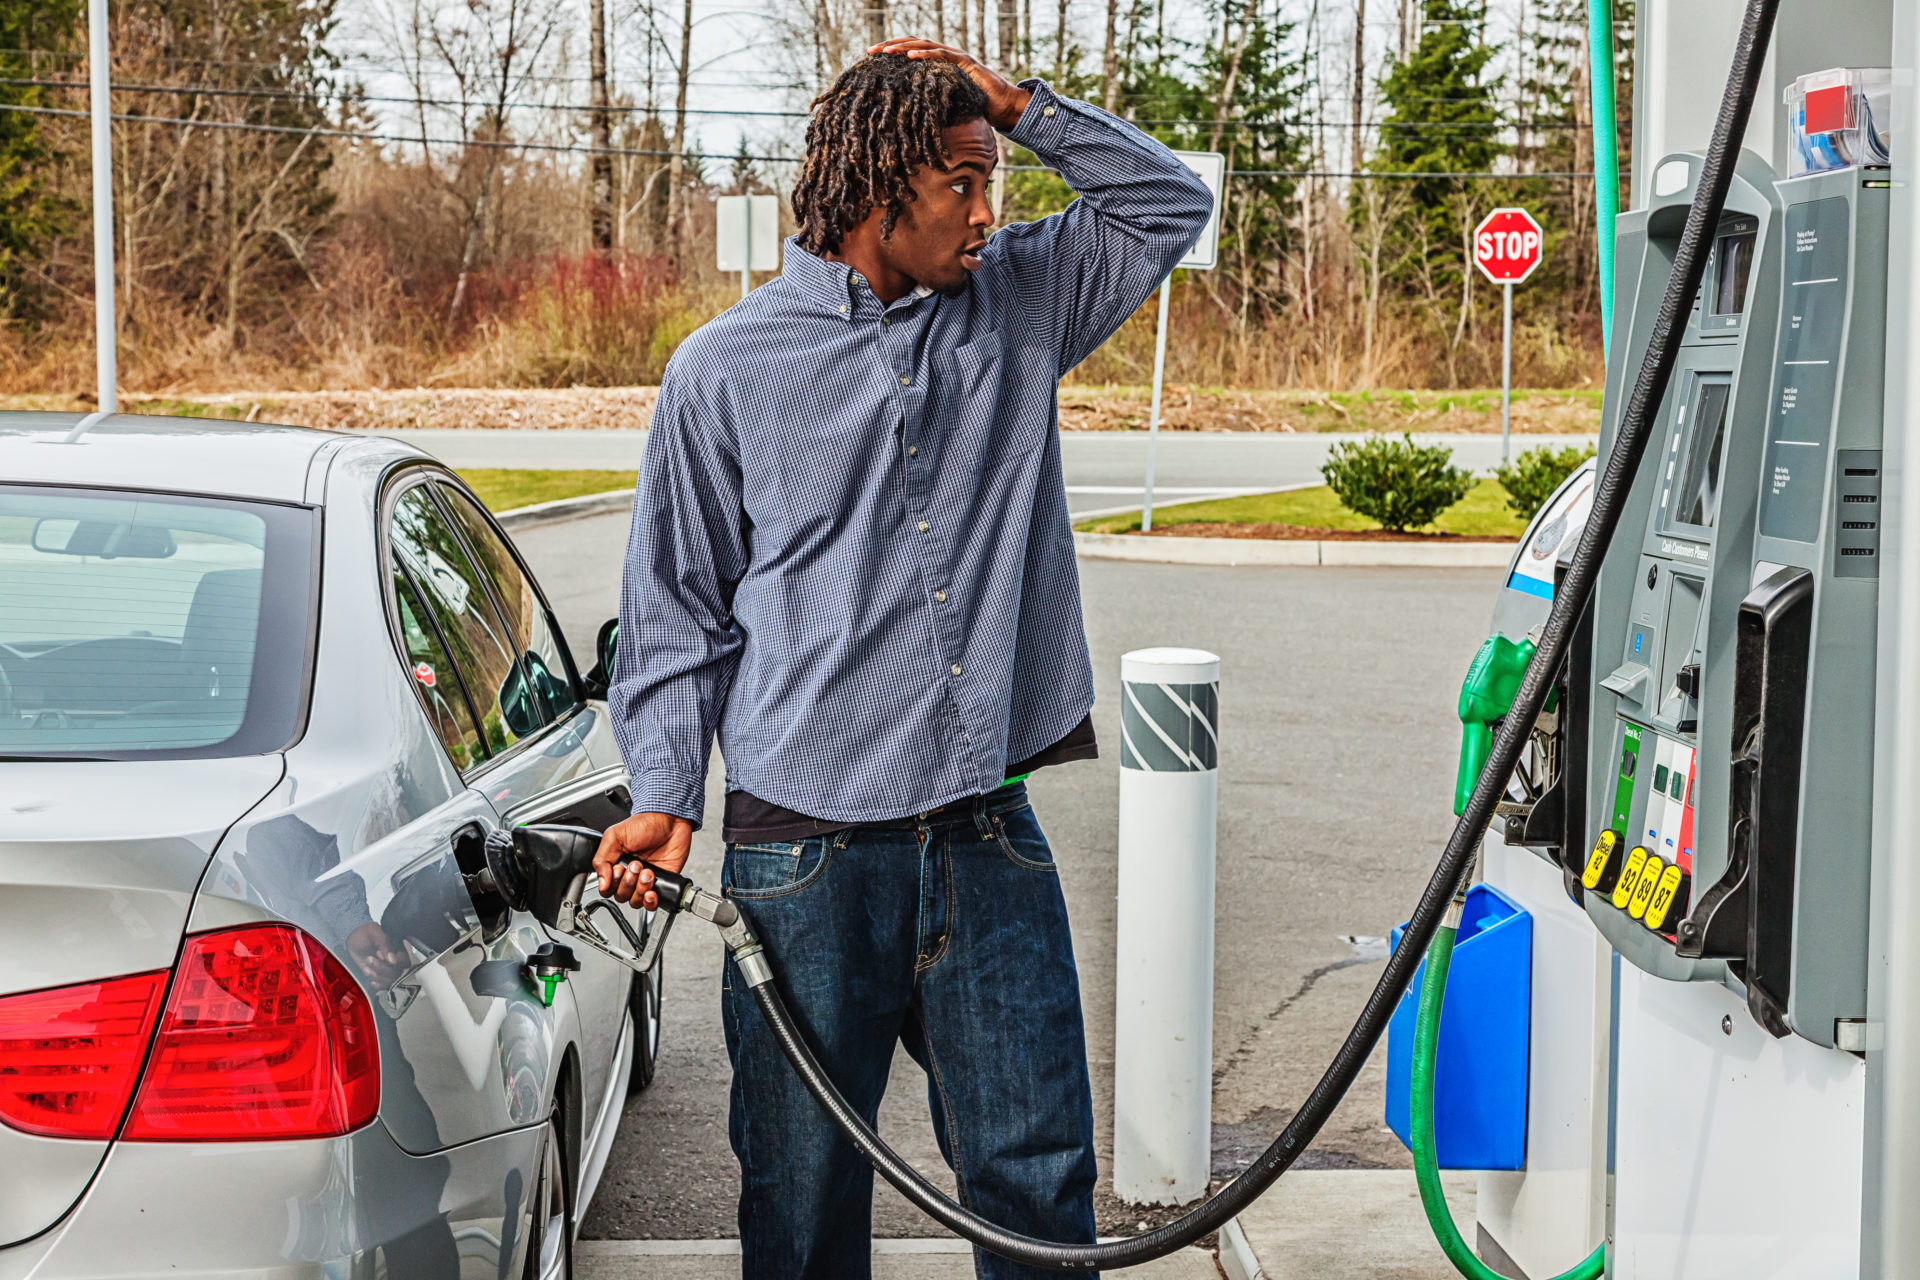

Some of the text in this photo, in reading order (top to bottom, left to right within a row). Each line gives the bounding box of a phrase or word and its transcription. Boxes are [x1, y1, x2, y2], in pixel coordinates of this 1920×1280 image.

[1478, 231, 1539, 261] STOP
[1671, 541, 1695, 558] Customers
[1694, 545, 1709, 561] Please
[1597, 836, 1614, 855] Diesel
[1621, 868, 1636, 893] 92
[1637, 878, 1652, 902] 89
[1654, 887, 1671, 912] 87
